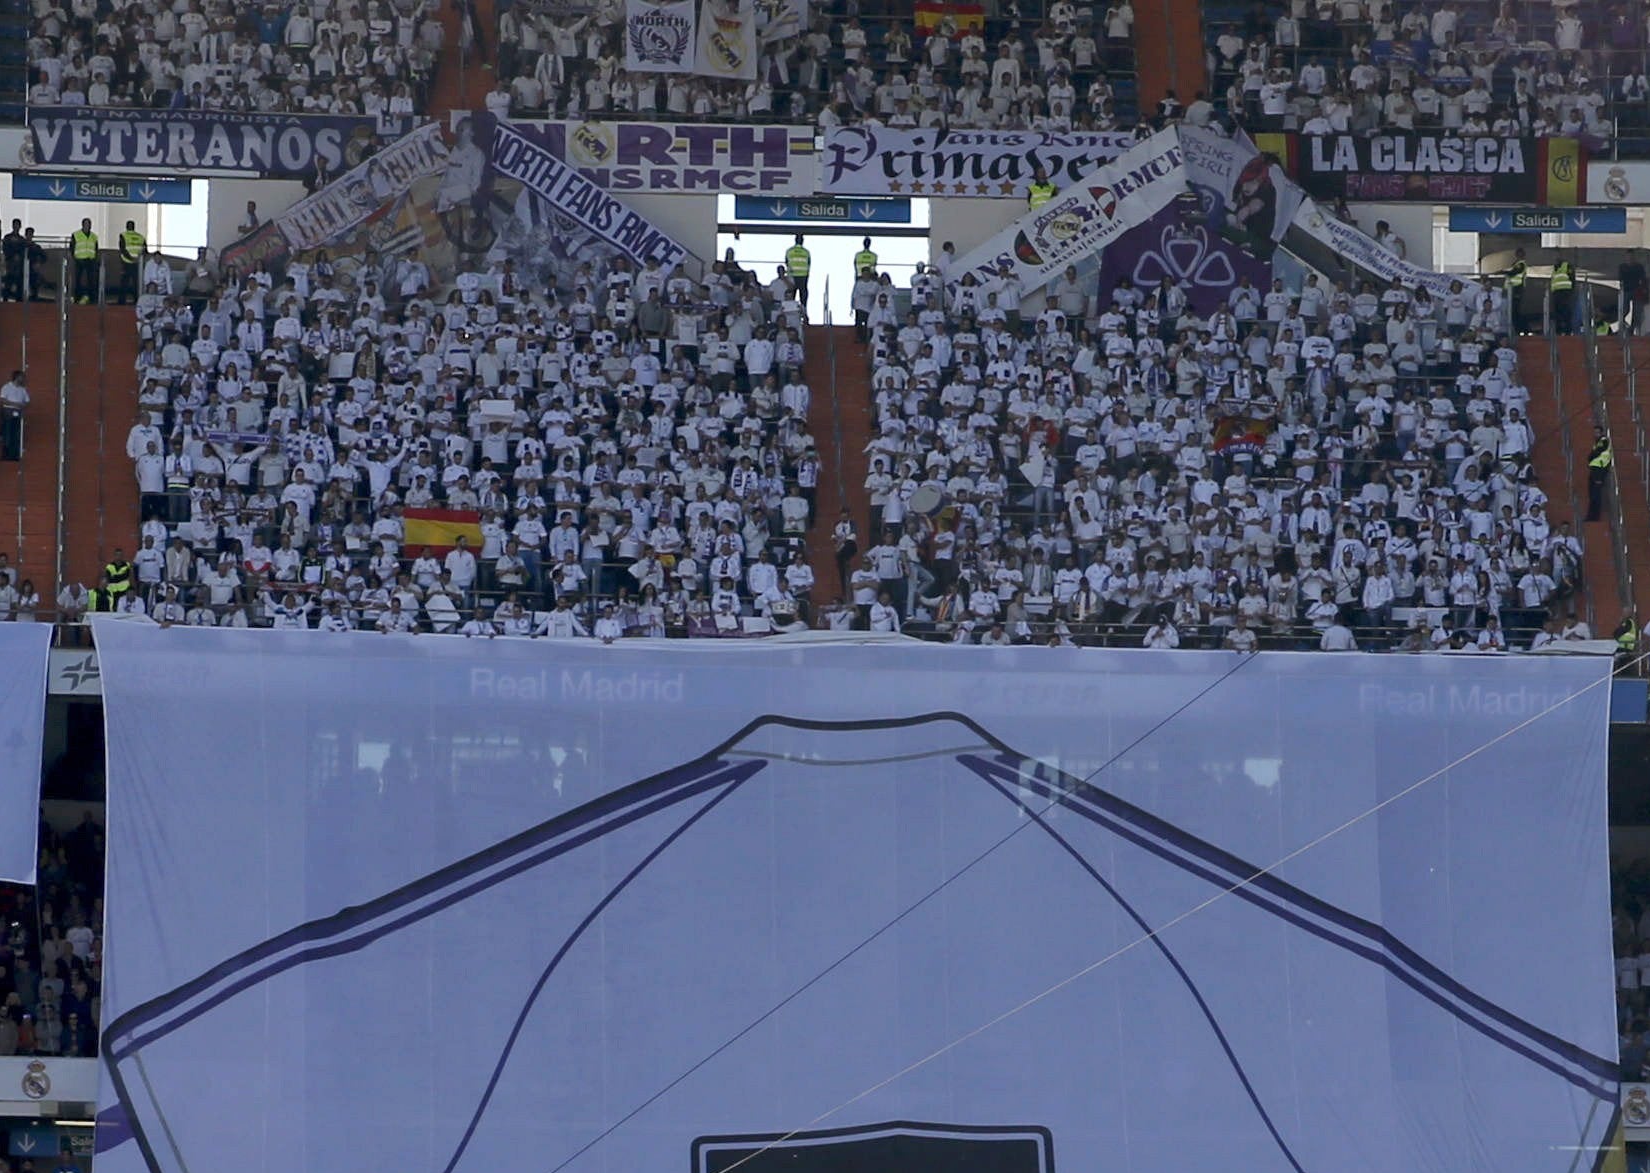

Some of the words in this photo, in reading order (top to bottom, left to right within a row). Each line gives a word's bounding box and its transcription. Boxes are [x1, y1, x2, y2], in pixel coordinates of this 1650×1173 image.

[151, 110, 302, 125] MADRIDISTA
[30, 118, 342, 171] VETERANOS
[1311, 136, 1359, 173] LA
[1370, 136, 1526, 175] CLASICA
[80, 182, 125, 197] Salida
[1111, 145, 1183, 202] RMCF
[555, 171, 624, 234] FANS
[801, 201, 845, 217] Salida
[1516, 214, 1559, 228] Salida
[469, 667, 546, 701] Real
[561, 670, 685, 704] Madrid
